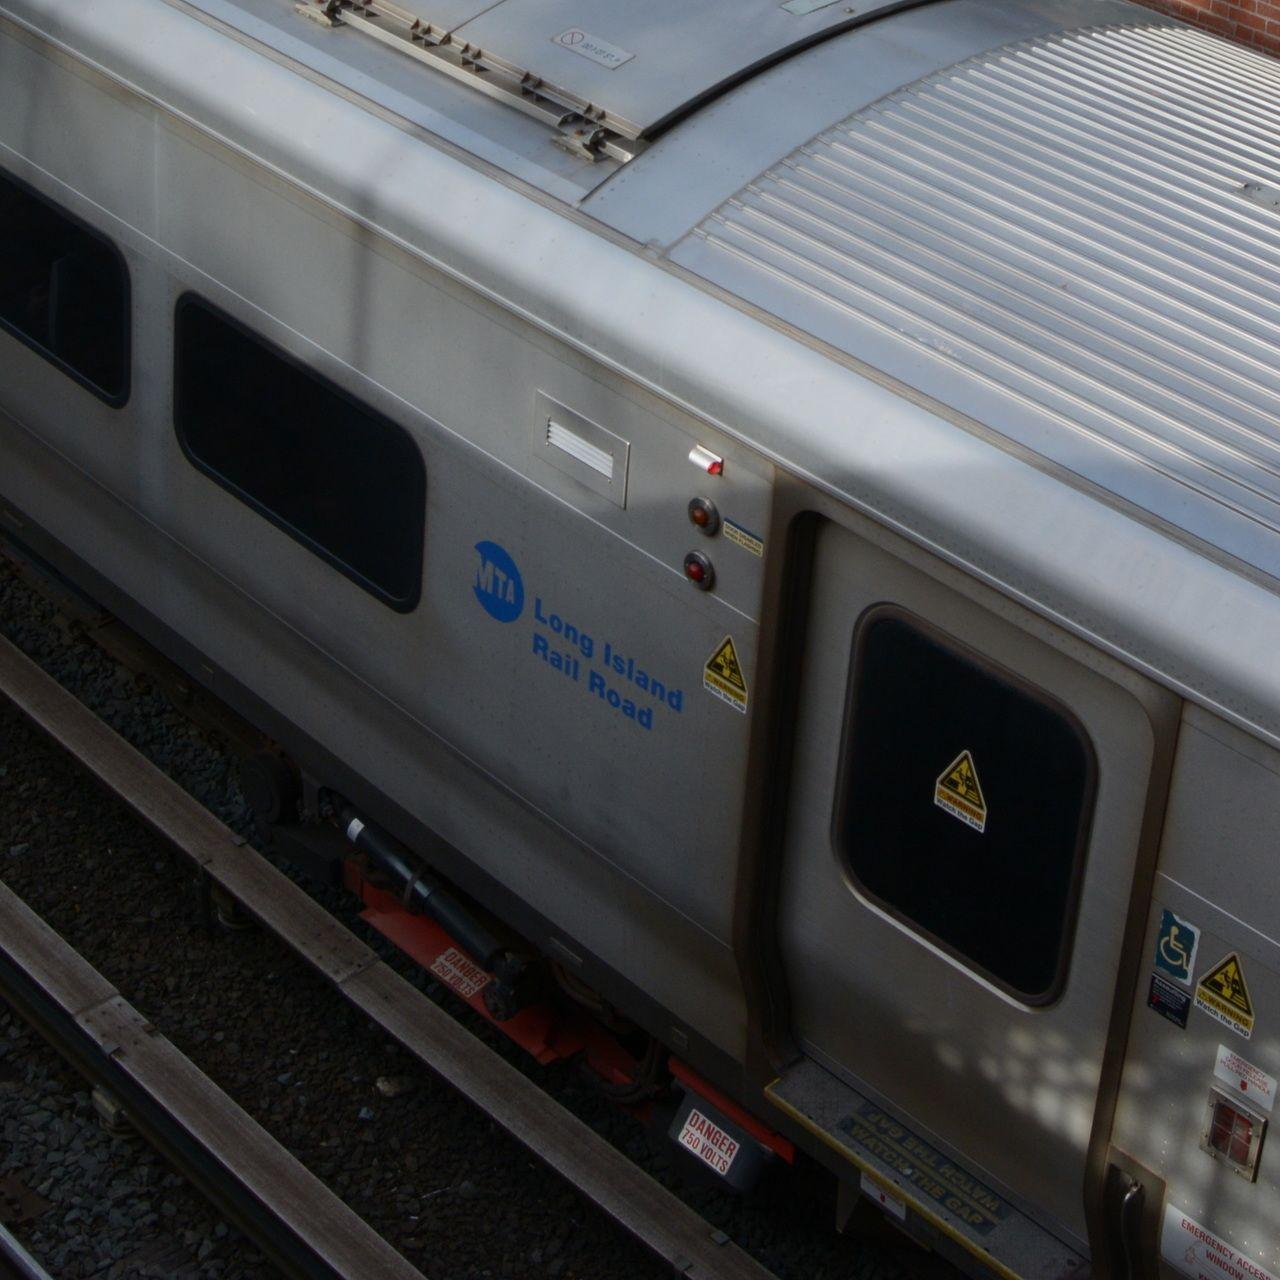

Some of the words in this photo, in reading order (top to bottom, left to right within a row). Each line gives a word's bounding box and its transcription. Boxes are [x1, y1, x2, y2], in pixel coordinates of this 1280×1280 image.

[534, 597, 593, 658] Long
[604, 641, 683, 713] Island
[533, 632, 579, 681] Rail
[588, 670, 653, 730] Road
[937, 797, 957, 814] Watch
[957, 810, 968, 821] the
[969, 818, 983, 830] Gap
[434, 961, 451, 978] 750
[445, 952, 487, 987] DANGER
[1196, 998, 1219, 1017] Watch
[1220, 1014, 1232, 1026] the
[1233, 1022, 1249, 1037] Gap
[1208, 997, 1248, 1027] WARNING
[682, 1128, 700, 1149] 750
[701, 1142, 728, 1172] VOLTS
[689, 1111, 736, 1158] DANGER
[1181, 1219, 1234, 1260] EMERGENCY
[1206, 1249, 1244, 1280] WINDOW
